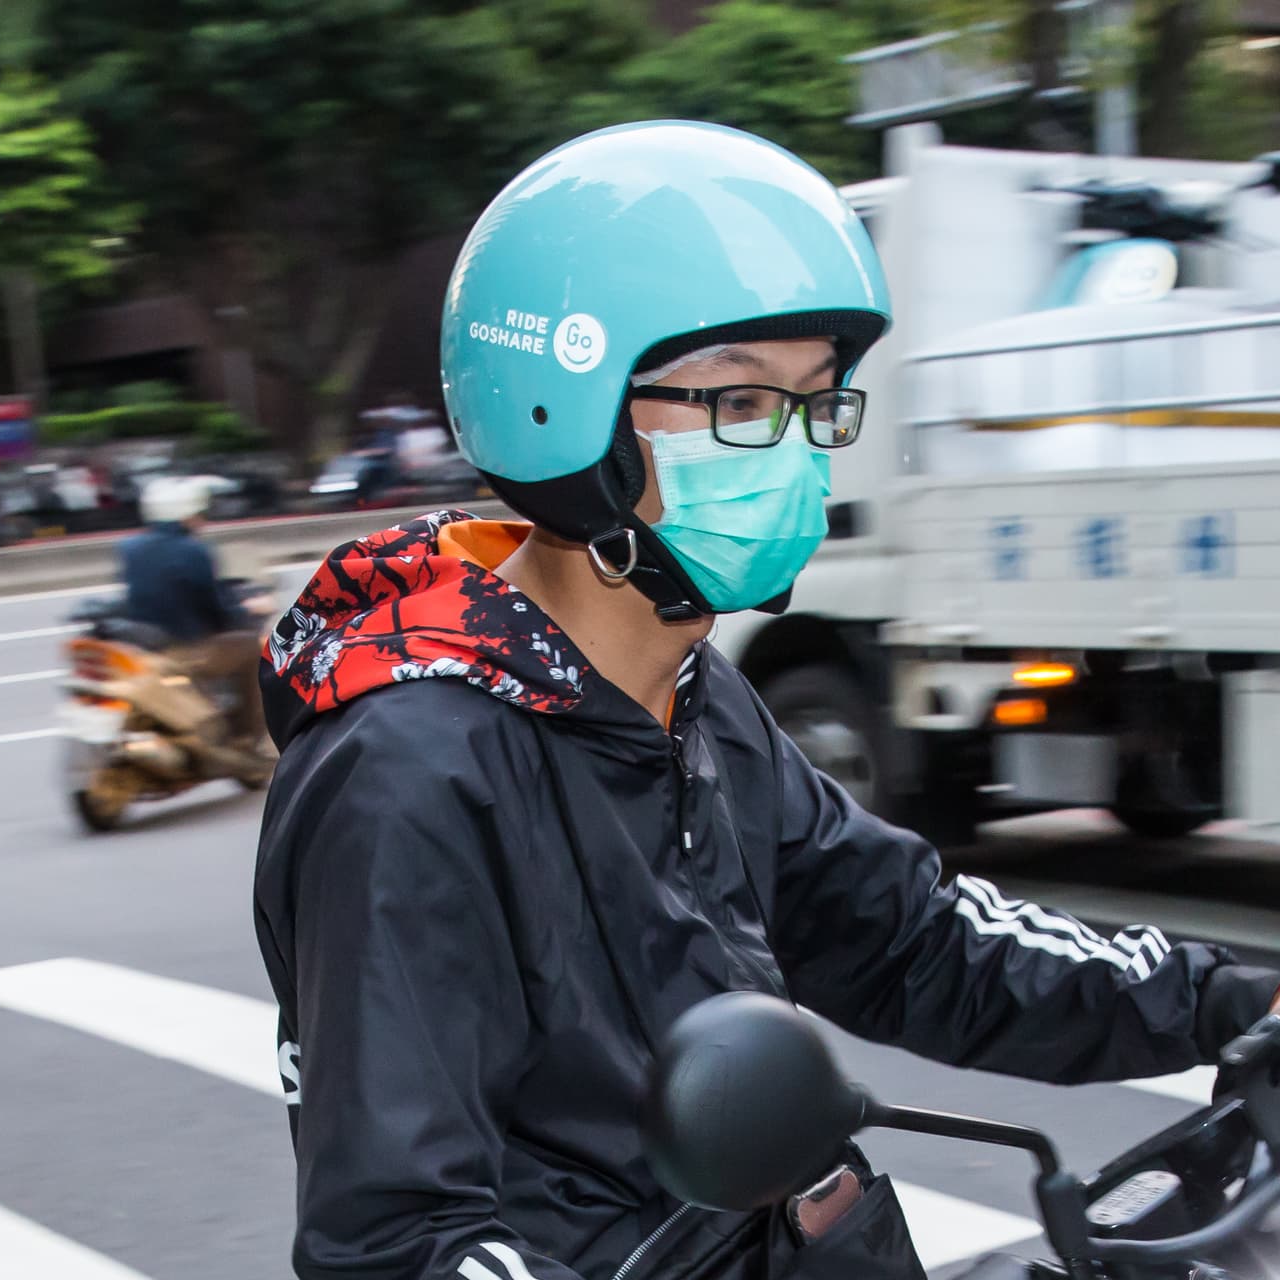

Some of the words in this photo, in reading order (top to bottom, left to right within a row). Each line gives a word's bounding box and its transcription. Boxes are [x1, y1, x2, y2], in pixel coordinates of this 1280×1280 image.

[507, 310, 549, 334] RIDE
[469, 322, 544, 355] GOSHARE
[568, 323, 592, 348] Go
